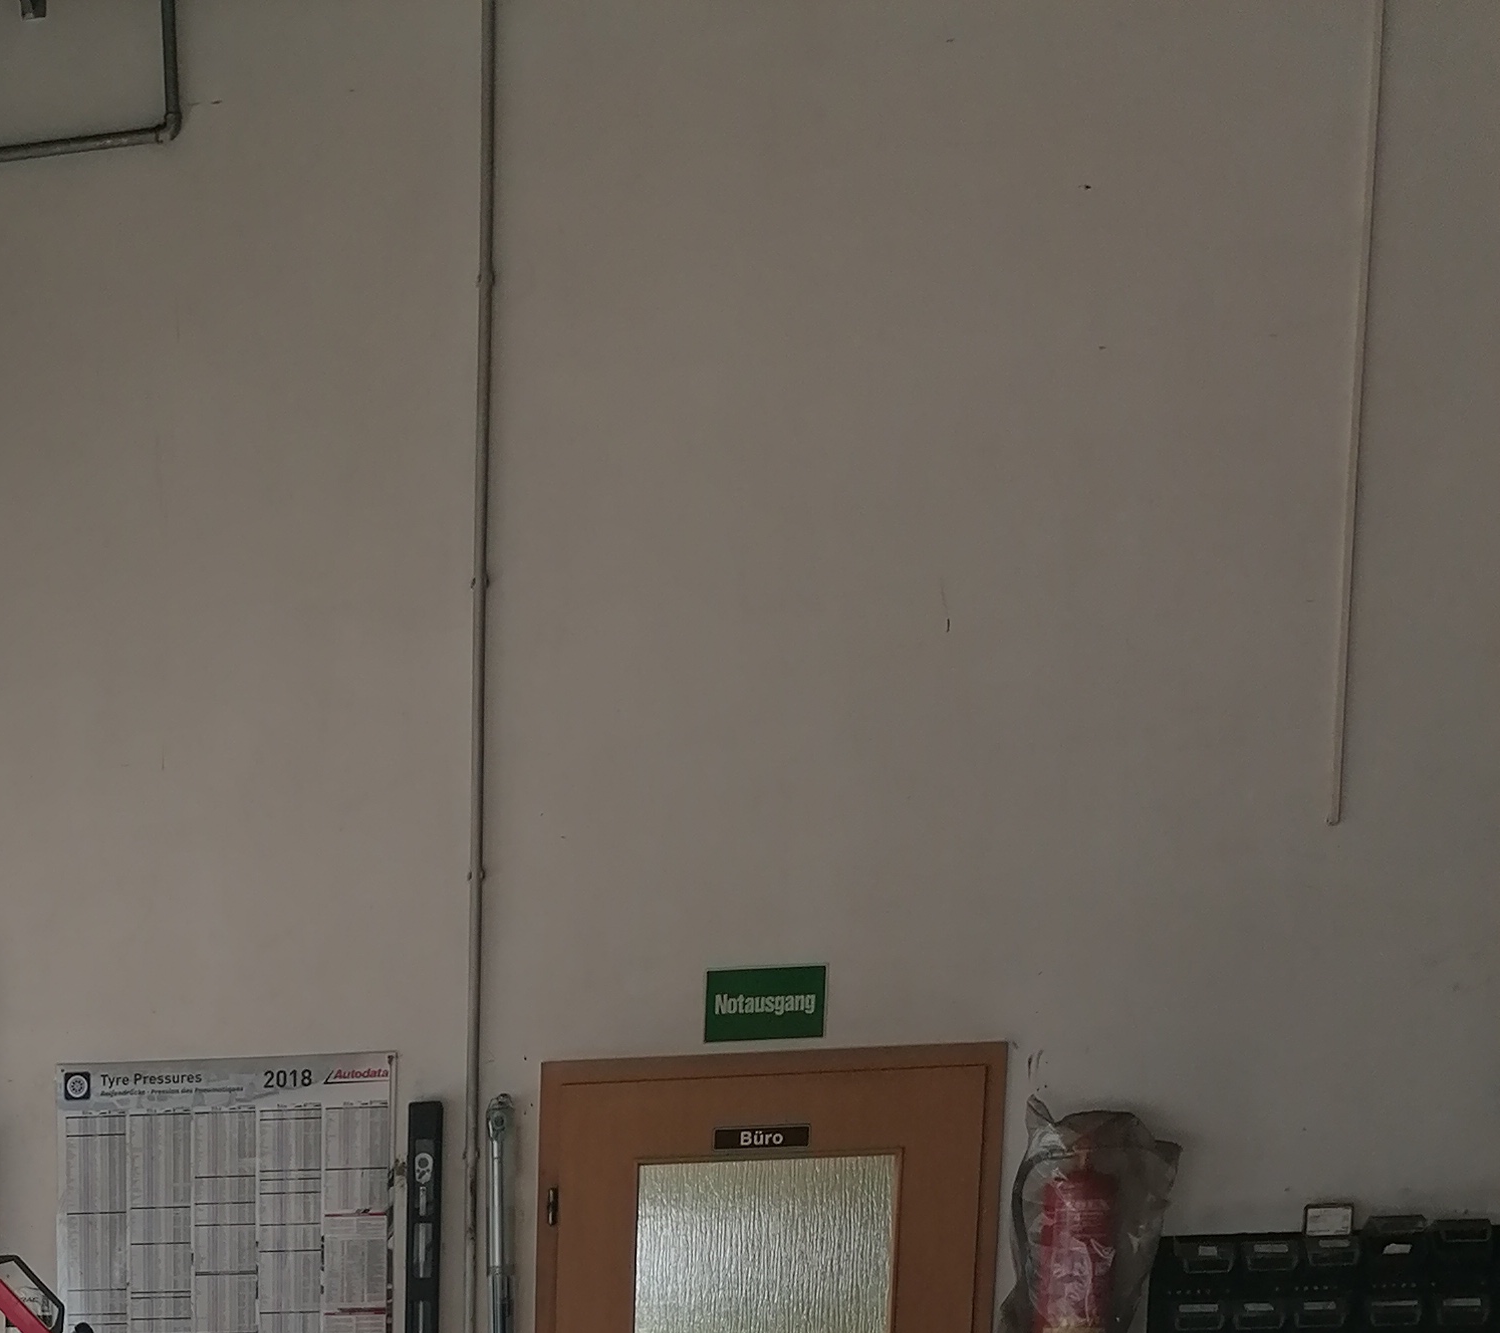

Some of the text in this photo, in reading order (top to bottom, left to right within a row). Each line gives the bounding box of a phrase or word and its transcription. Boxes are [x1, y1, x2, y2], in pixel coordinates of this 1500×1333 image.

[714, 993, 817, 1016] Notausgang
[100, 1071, 202, 1089] Tyre Pressures
[263, 1069, 312, 1088] 2018
[333, 1067, 389, 1080] Autodata
[739, 1131, 784, 1147] Büro
